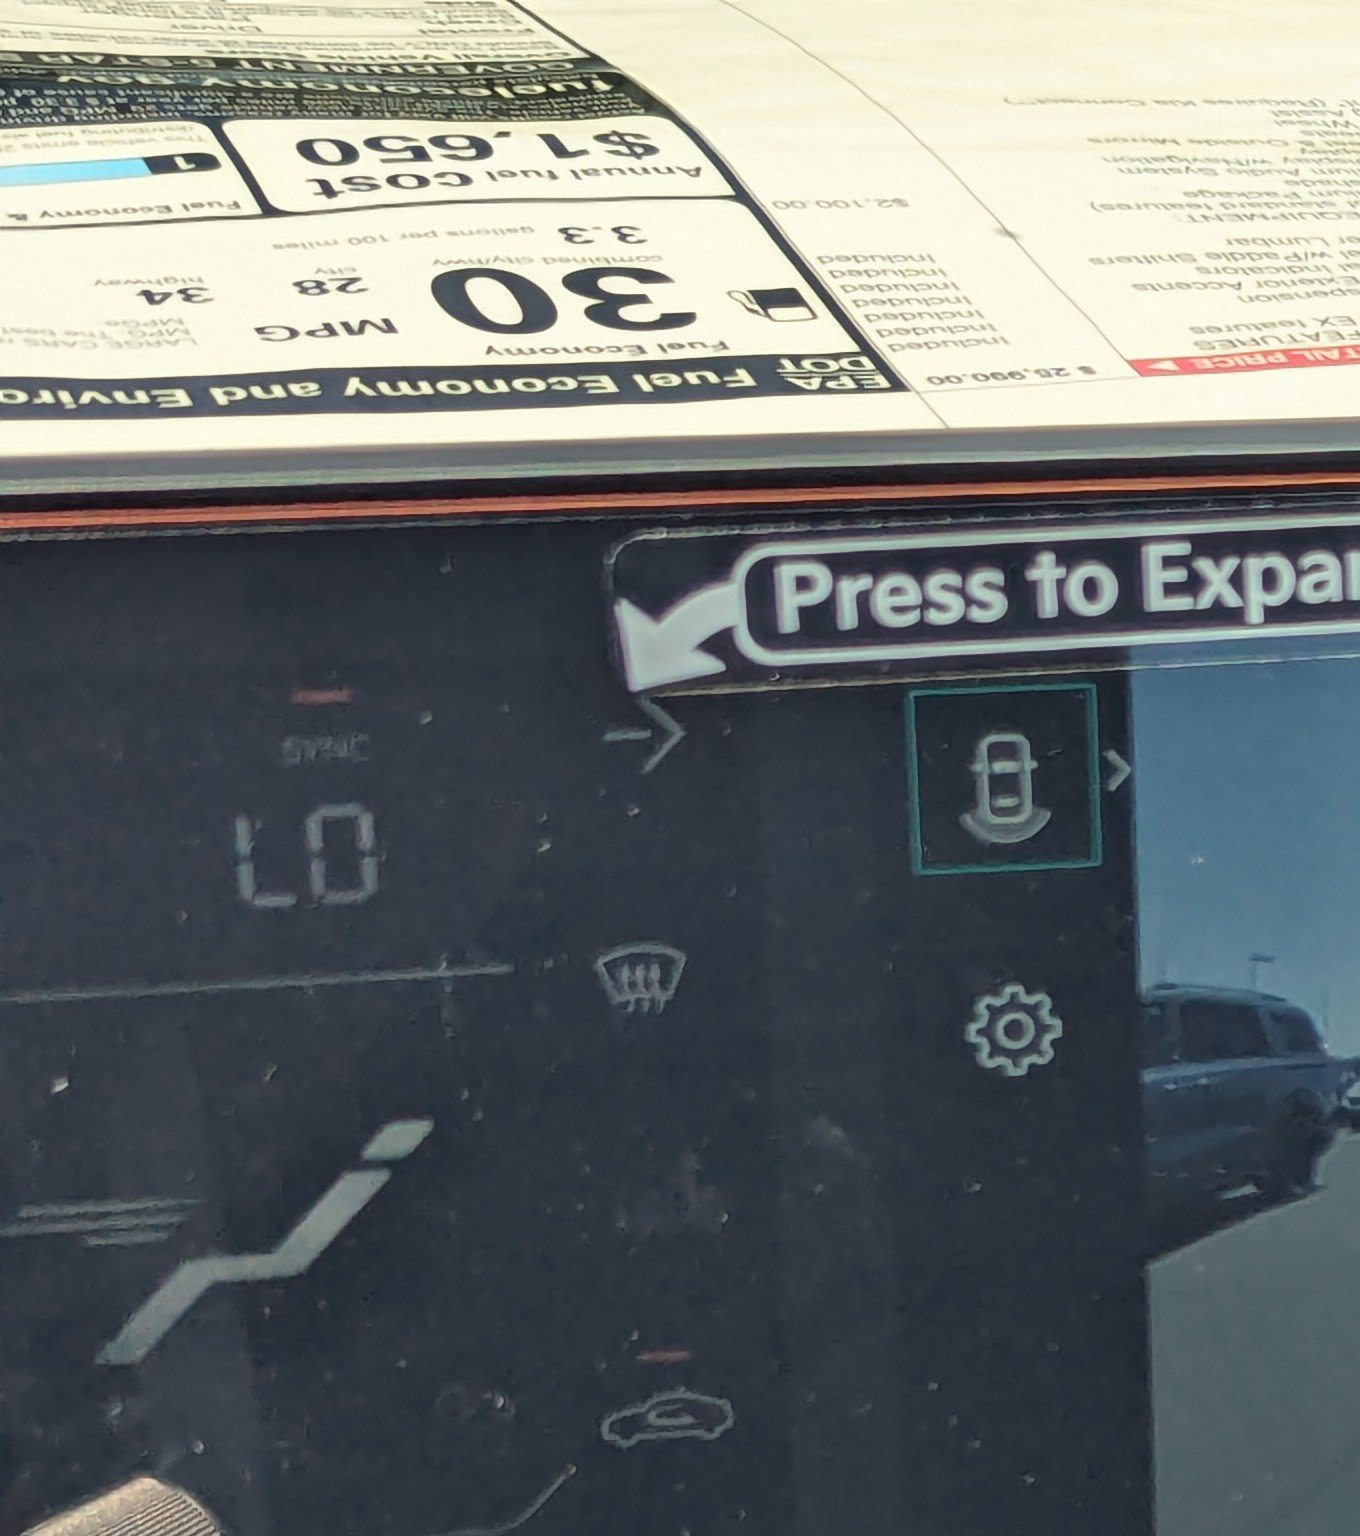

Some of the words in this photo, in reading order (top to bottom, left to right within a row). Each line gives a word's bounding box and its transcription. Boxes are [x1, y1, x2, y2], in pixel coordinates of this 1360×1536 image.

[234, 59, 574, 75] GOVERNMENT
[296, 130, 660, 167] $1,650
[173, 155, 197, 169] 1
[485, 169, 560, 182] fuel
[570, 166, 703, 180] Annual
[305, 171, 473, 200] cost
[1181, 189, 1302, 199] Package
[180, 199, 241, 211] Fuel
[38, 206, 173, 221] Economy
[557, 226, 648, 245] 3.3
[1224, 236, 1330, 247] Lumbar
[816, 253, 936, 266] Included
[1087, 253, 1198, 266] Shifters
[827, 268, 948, 279] Included
[1194, 264, 1333, 276] Indicators
[291, 276, 369, 296] 28
[839, 281, 960, 294] Included
[1131, 281, 1244, 293] Accents
[1253, 275, 1360, 289] Exterior
[136, 287, 215, 306] 34
[430, 266, 698, 335] 30
[851, 295, 972, 309] Included
[863, 309, 984, 323] Included
[1310, 316, 1357, 327] EX
[253, 317, 398, 342] MPG
[875, 323, 997, 338] Included
[1188, 320, 1308, 334] features
[484, 345, 647, 357] Economy
[658, 340, 730, 354] Fuel
[887, 335, 1010, 353] Included
[776, 356, 877, 372] DOT
[1188, 352, 1288, 369] PRICE
[343, 373, 620, 398] Economy
[631, 368, 757, 392] Fuel
[782, 374, 892, 390] EPA
[210, 381, 322, 406] and
[772, 558, 1007, 634] Press
[1033, 551, 1120, 620] to
[232, 802, 380, 909] LO
